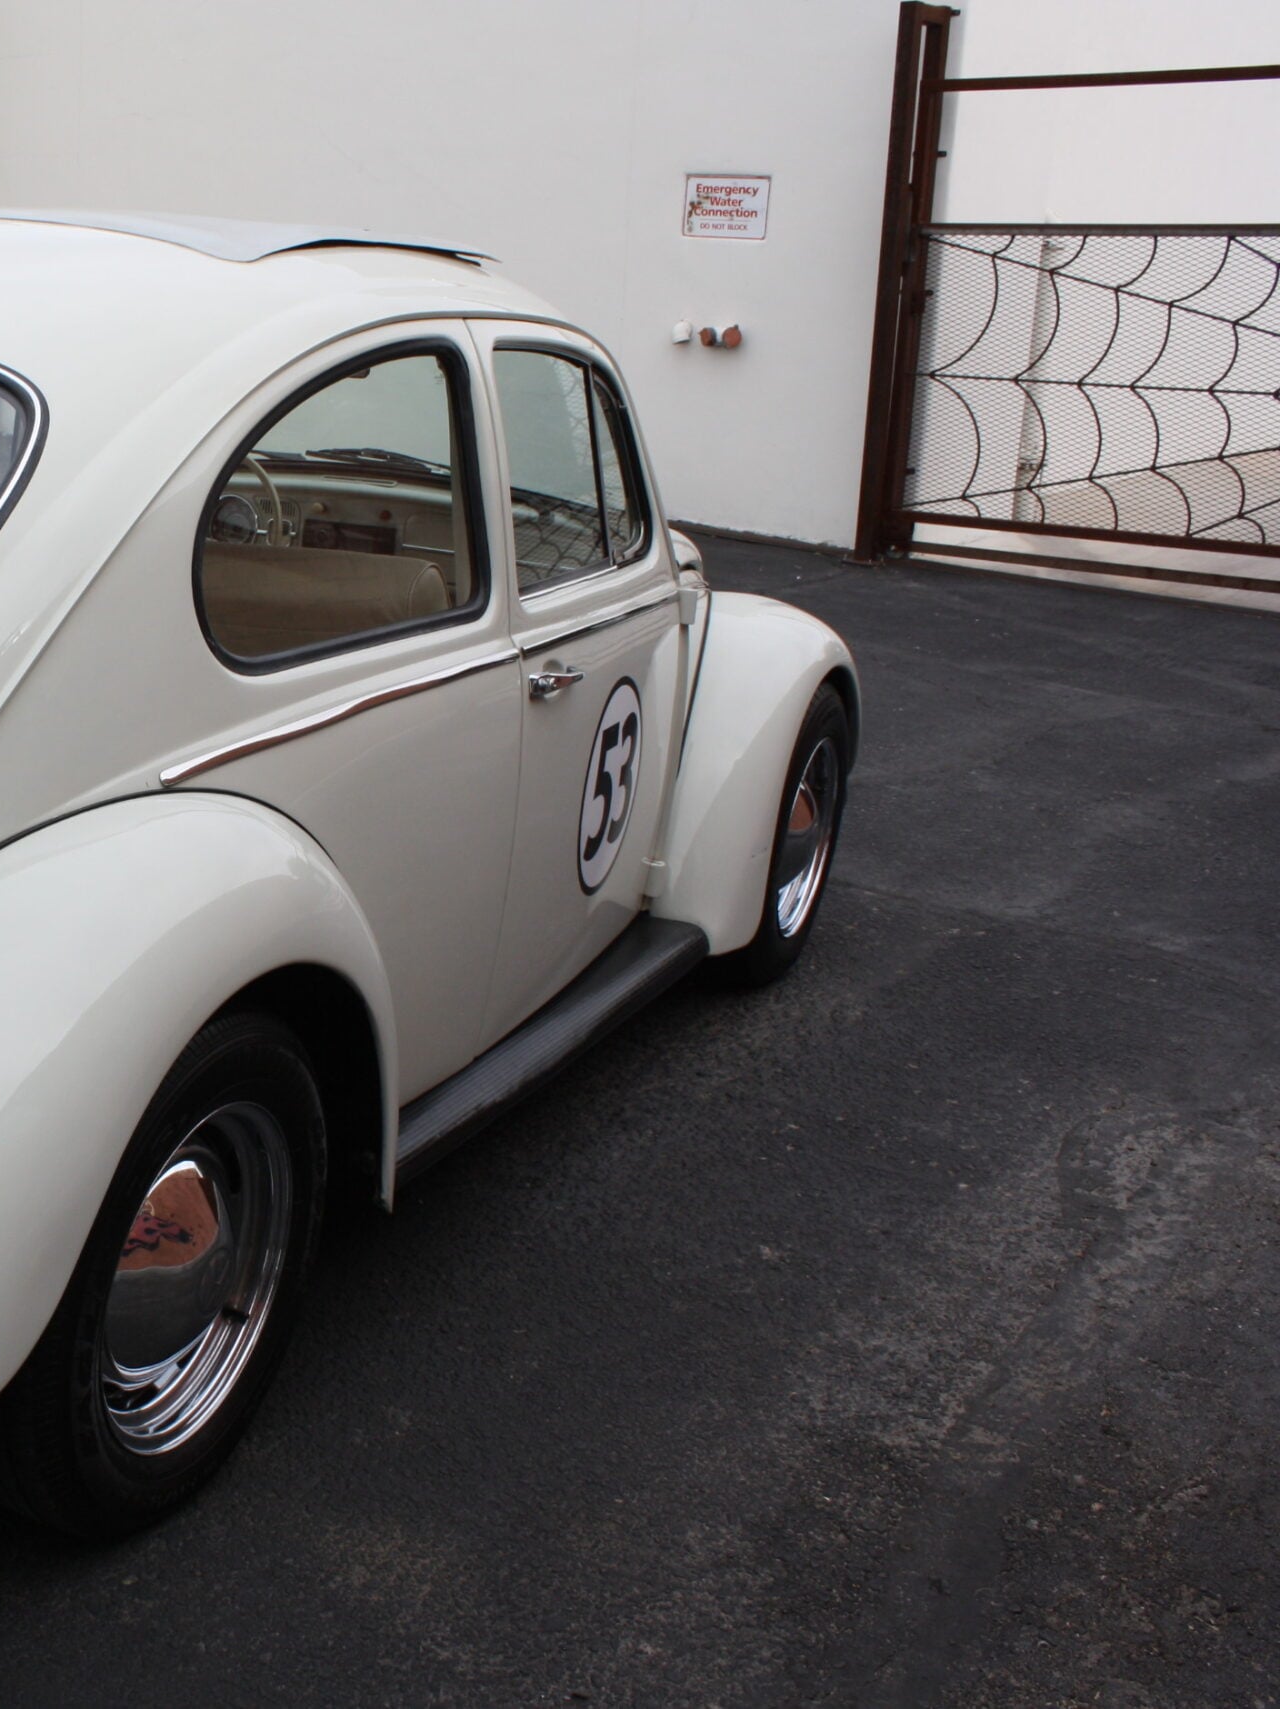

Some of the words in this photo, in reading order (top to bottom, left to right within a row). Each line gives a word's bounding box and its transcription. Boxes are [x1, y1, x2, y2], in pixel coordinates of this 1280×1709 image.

[696, 183, 760, 197] Emergency
[710, 197, 744, 207] Water
[694, 207, 758, 218] Connection
[700, 222, 710, 230] DO
[727, 223, 748, 231] BLOCK
[584, 712, 638, 862] 53
